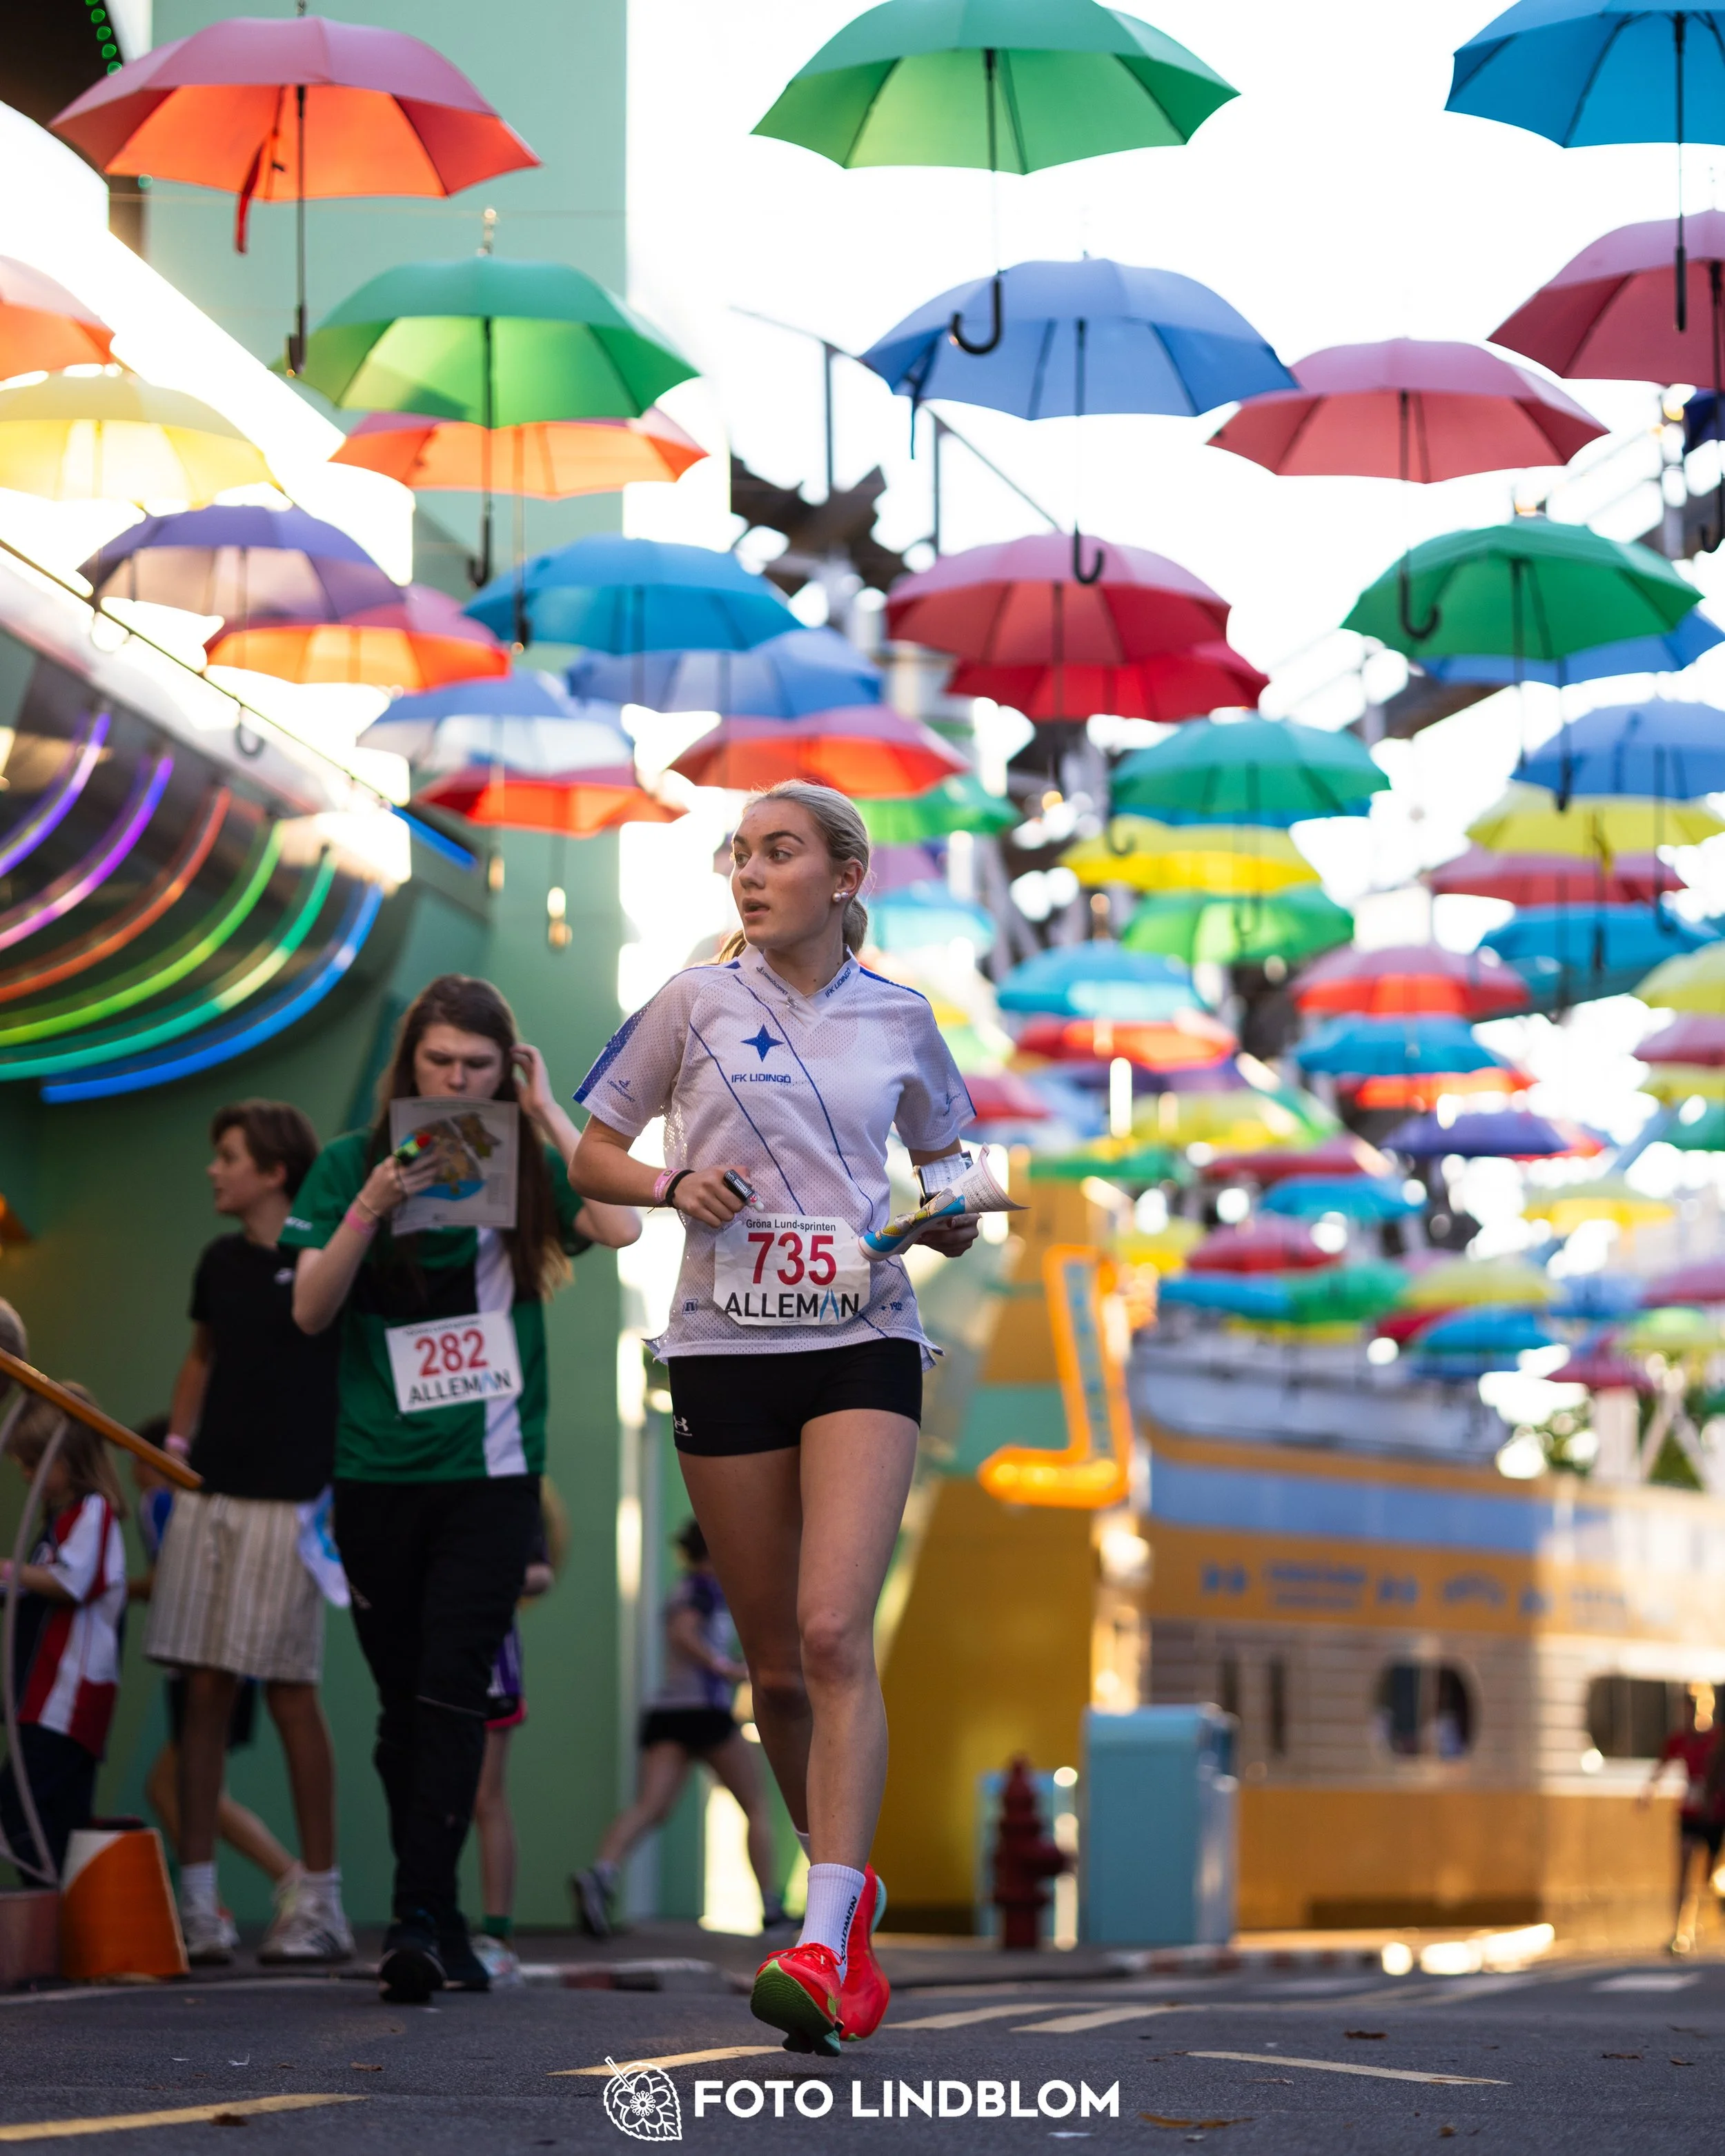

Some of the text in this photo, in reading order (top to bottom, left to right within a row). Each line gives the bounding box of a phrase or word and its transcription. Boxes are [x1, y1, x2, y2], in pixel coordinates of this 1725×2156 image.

[825, 986, 835, 998] IFK
[731, 1074, 791, 1083] IFK LIDINGÖ
[746, 1219, 836, 1232] Gröna Lund-sprinten
[748, 1232, 837, 1285] 735
[415, 1328, 489, 1376] 282
